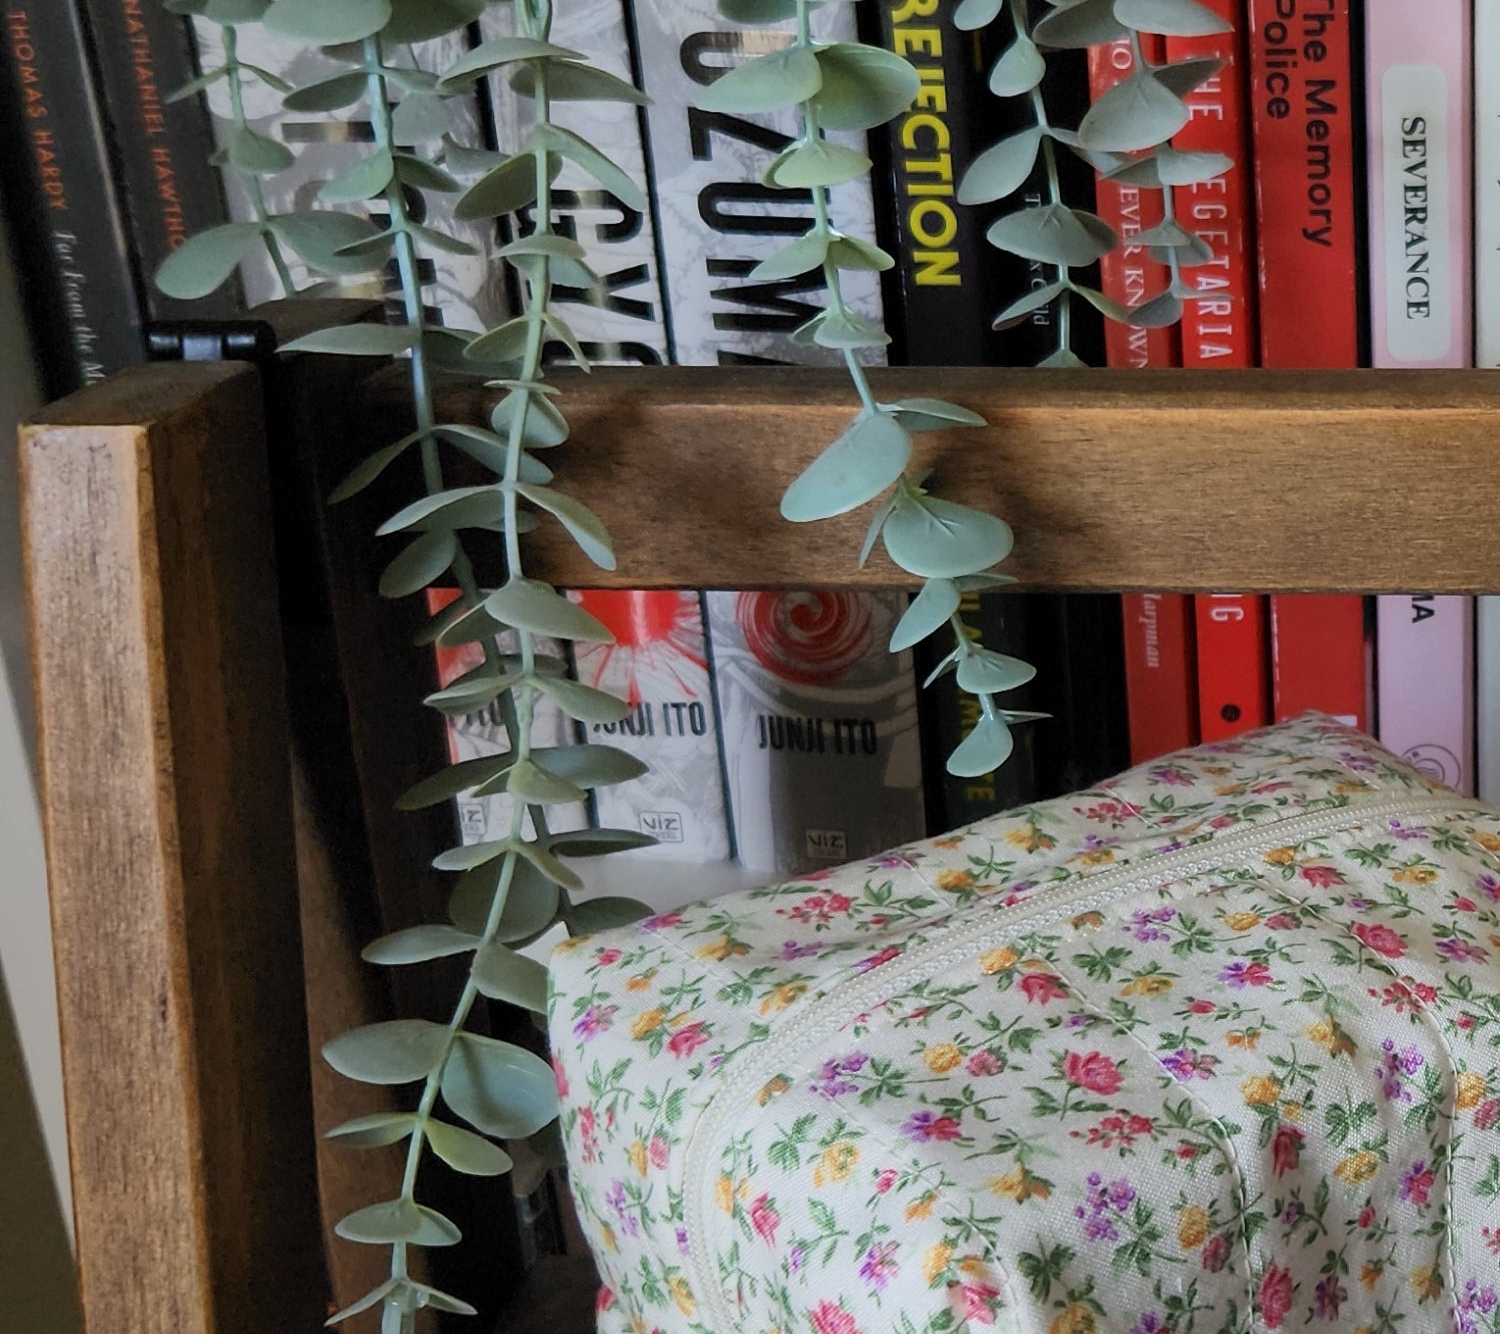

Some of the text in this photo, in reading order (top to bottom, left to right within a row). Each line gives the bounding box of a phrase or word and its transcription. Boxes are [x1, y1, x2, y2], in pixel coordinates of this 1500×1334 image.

[6, 10, 71, 212] THOMAS HARDY
[1301, 76, 1338, 248] Memory
[679, 30, 835, 366] UZUM
[1120, 188, 1142, 258] EVER
[1191, 177, 1233, 359] EGETARIA
[1401, 116, 1431, 321] SEVERANCE
[74, 323, 100, 354] the
[663, 701, 707, 737] ITO
[758, 714, 878, 756] JUNJI ITO
